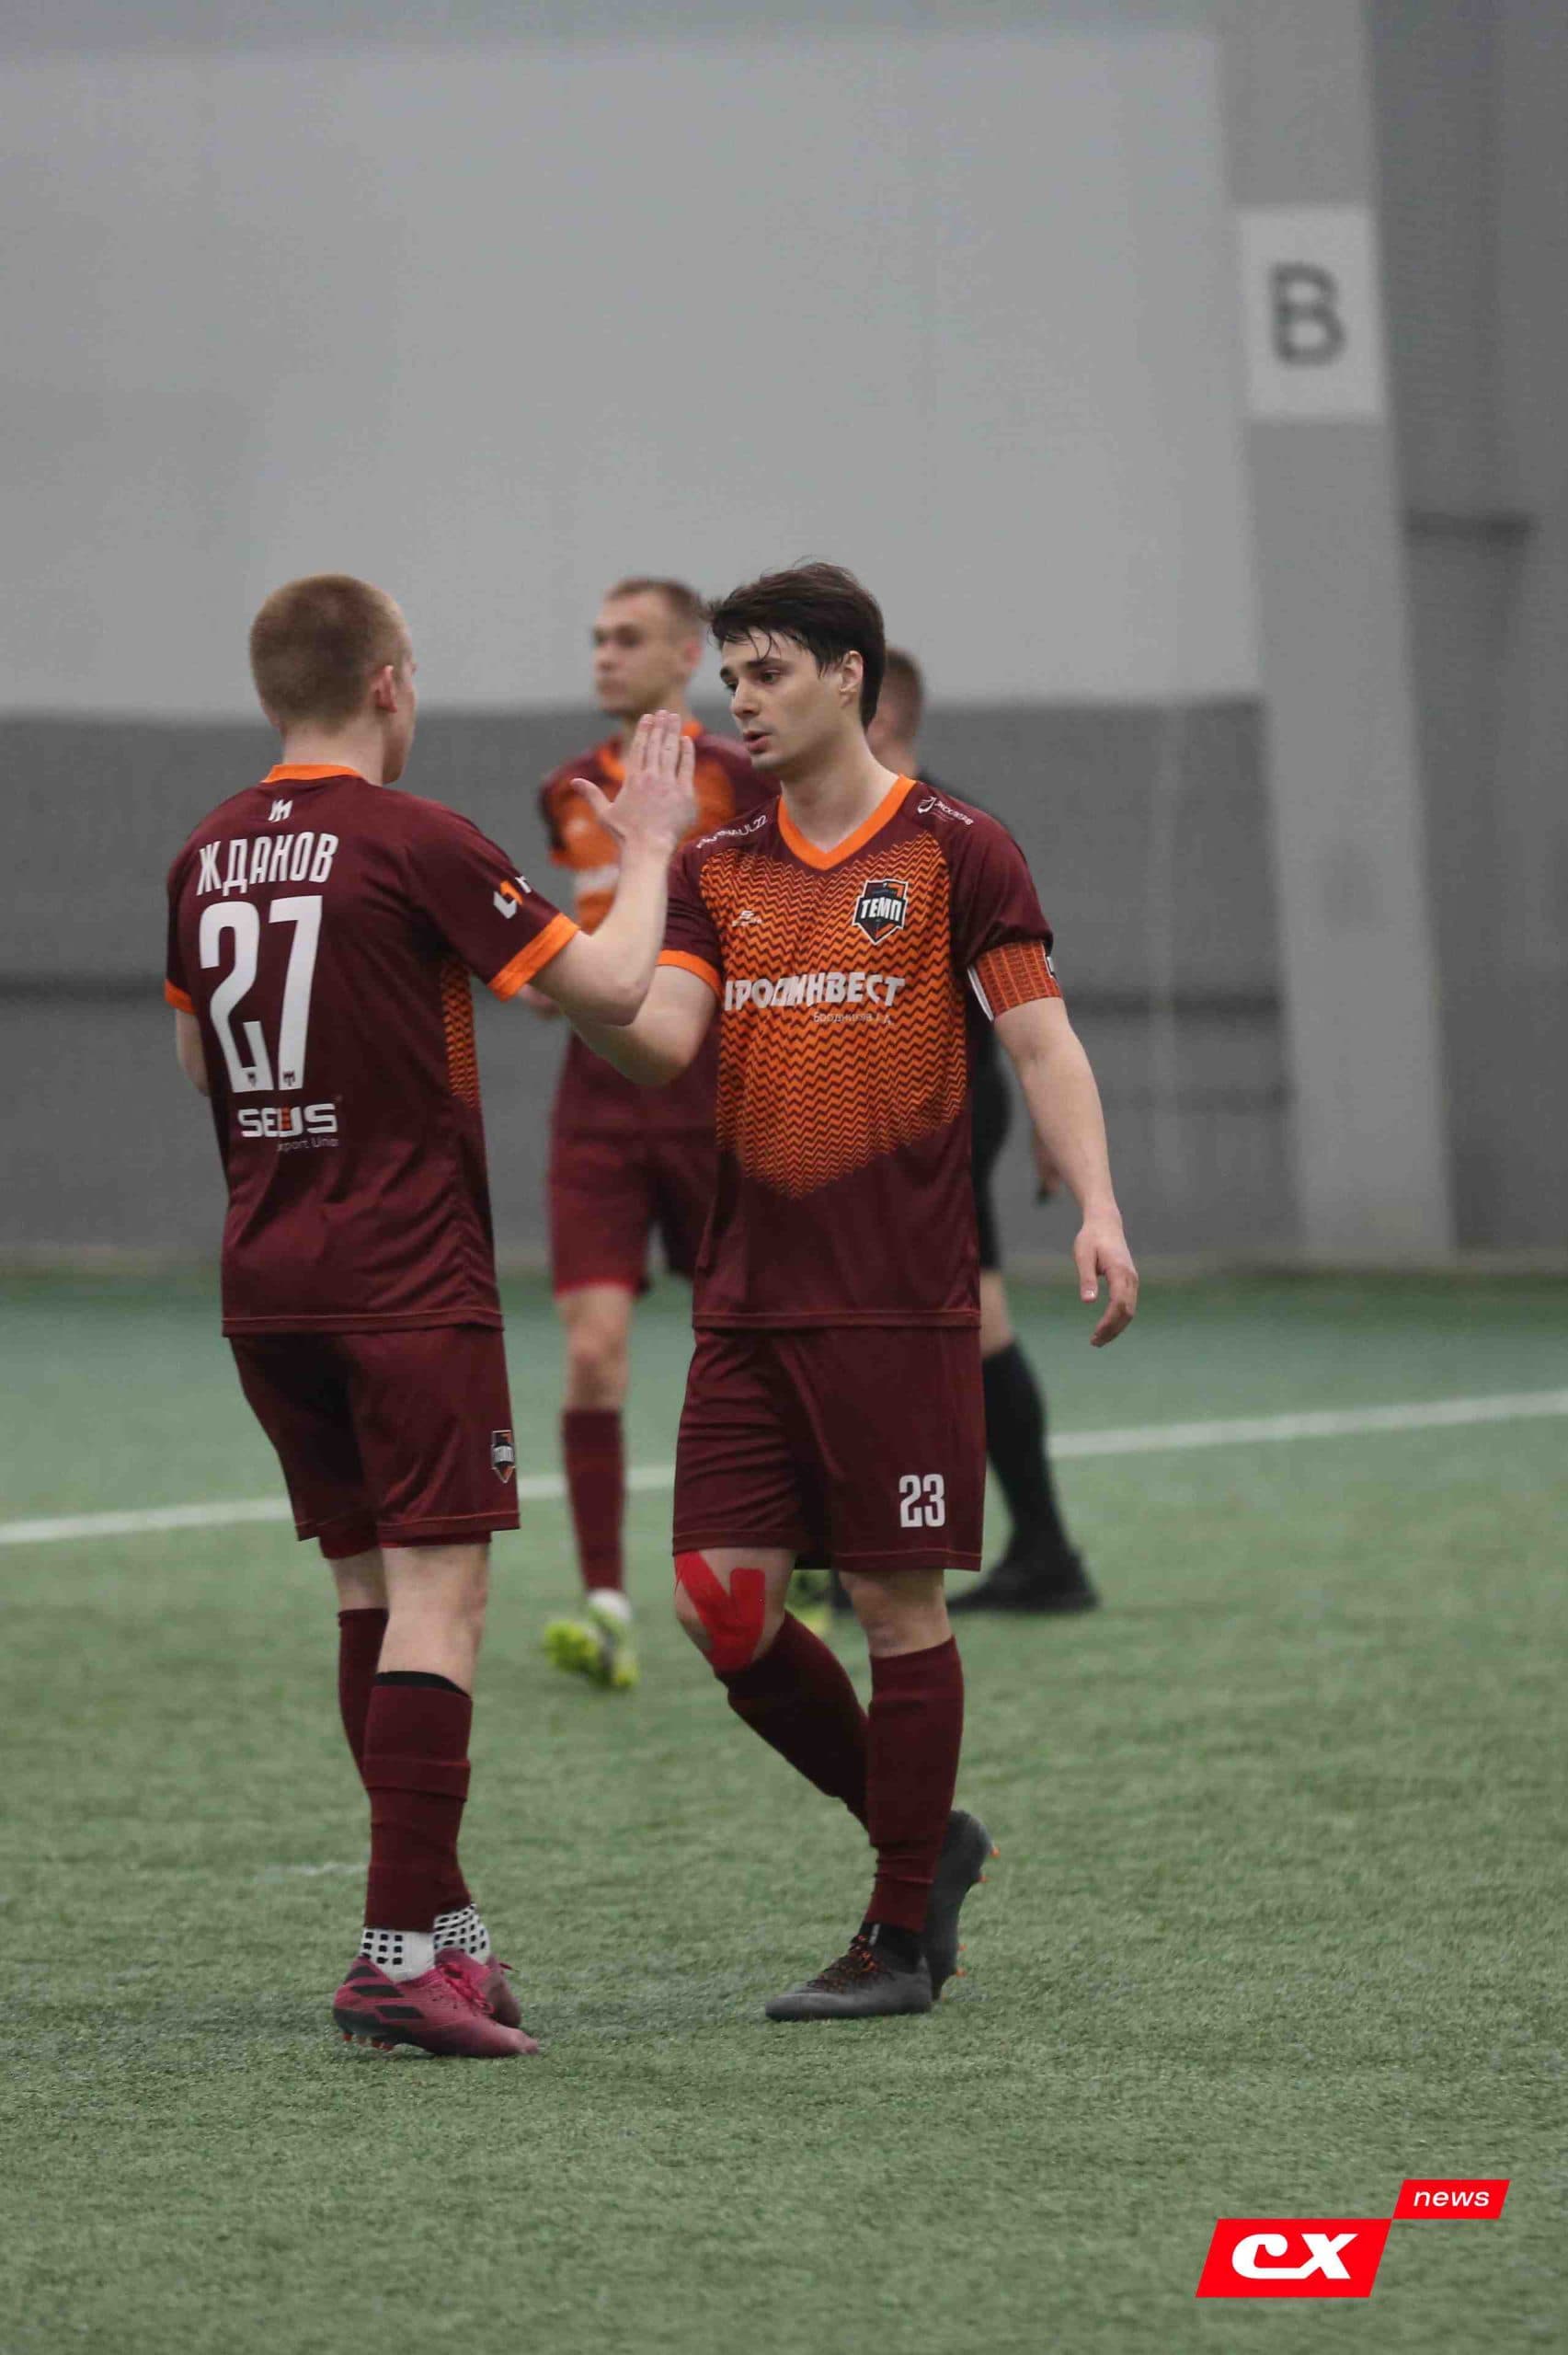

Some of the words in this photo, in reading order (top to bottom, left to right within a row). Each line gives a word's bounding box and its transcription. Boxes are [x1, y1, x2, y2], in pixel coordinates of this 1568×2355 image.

[196, 831, 339, 897] ЖДАНОВ
[860, 896, 902, 922] ТЕМП
[199, 895, 323, 1093] 27
[898, 1473, 945, 1528] 23
